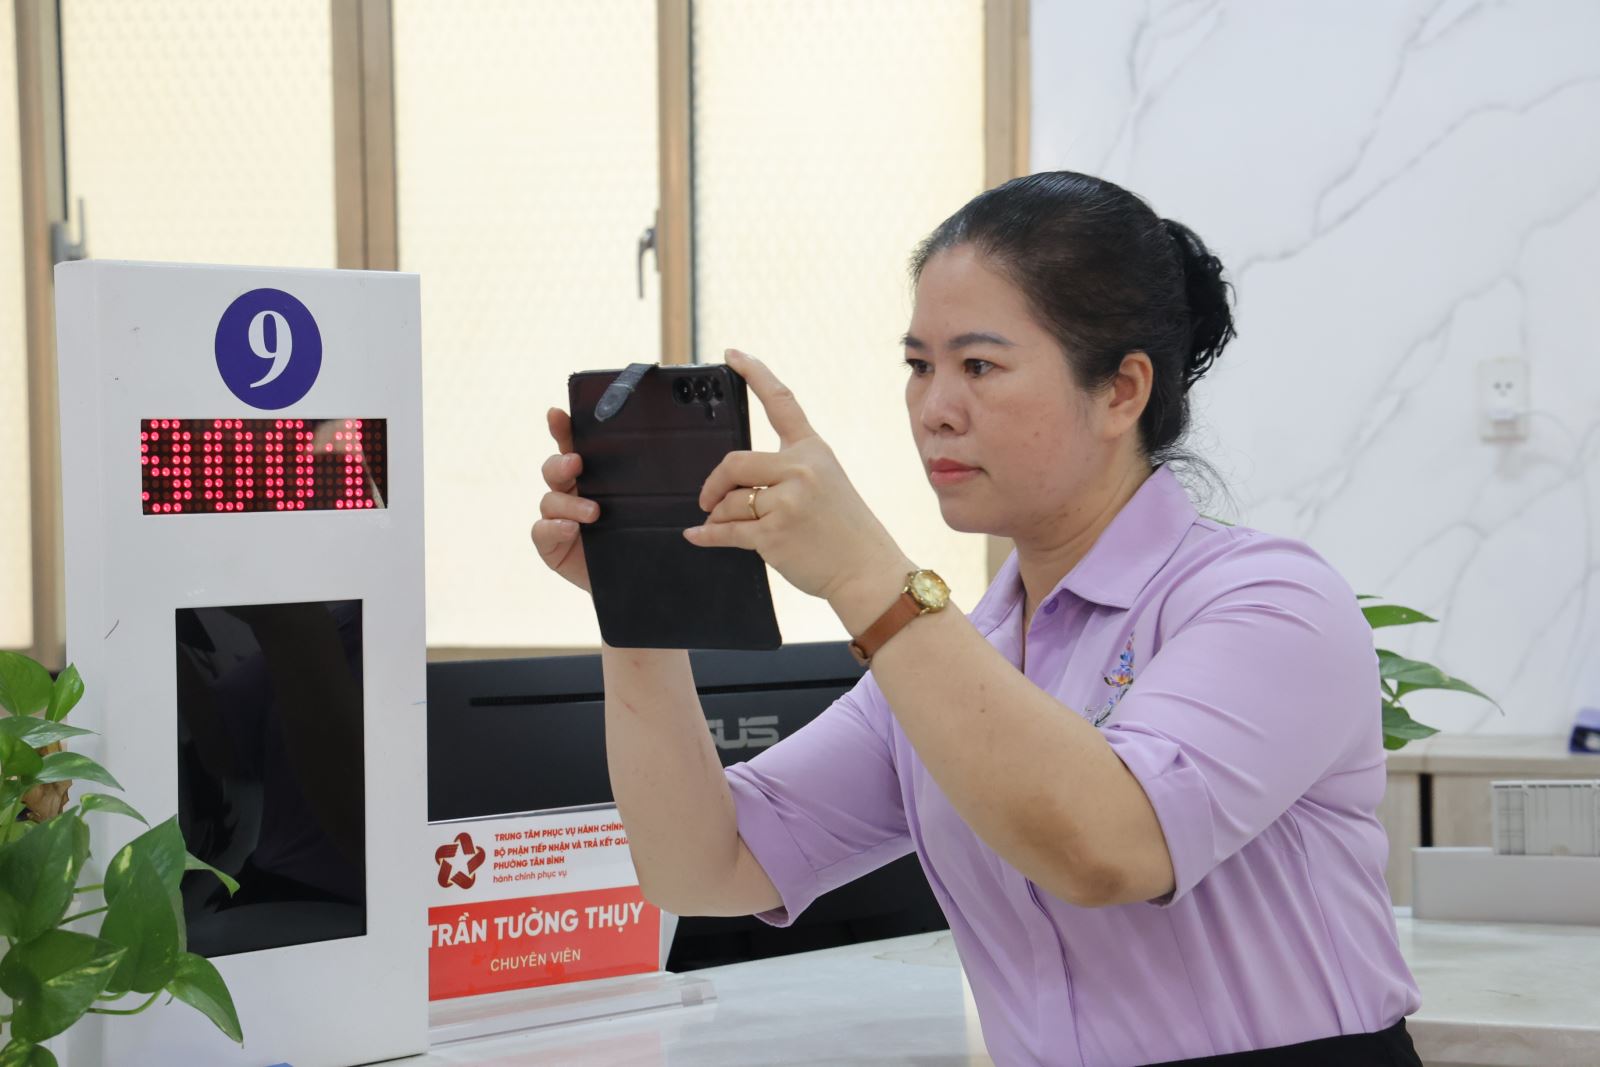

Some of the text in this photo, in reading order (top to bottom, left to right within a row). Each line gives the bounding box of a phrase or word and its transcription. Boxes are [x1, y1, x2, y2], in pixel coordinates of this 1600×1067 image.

[248, 310, 292, 388] 9
[707, 716, 779, 750] US
[495, 832, 522, 842] TRUNG
[525, 829, 540, 839] TÂM
[542, 828, 563, 838] PHỤC
[565, 826, 576, 836] VỤ
[578, 824, 599, 834] HÀNH
[494, 848, 505, 858] BỘ
[508, 845, 528, 856] PHẬN
[531, 842, 546, 853] TIẾP
[549, 841, 569, 852] NHẬN
[572, 840, 581, 849] VÀ
[584, 838, 598, 848] TRẢ
[600, 836, 612, 847] KẾT
[530, 857, 544, 866] TÂN
[547, 856, 565, 864] BÌNH
[493, 875, 512, 883] hành
[515, 871, 535, 881] chính
[538, 871, 556, 880] phục
[428, 901, 644, 948] TRẦN TƯỜNG THỤY
[491, 947, 581, 972] CHUYÊN VIÊN
